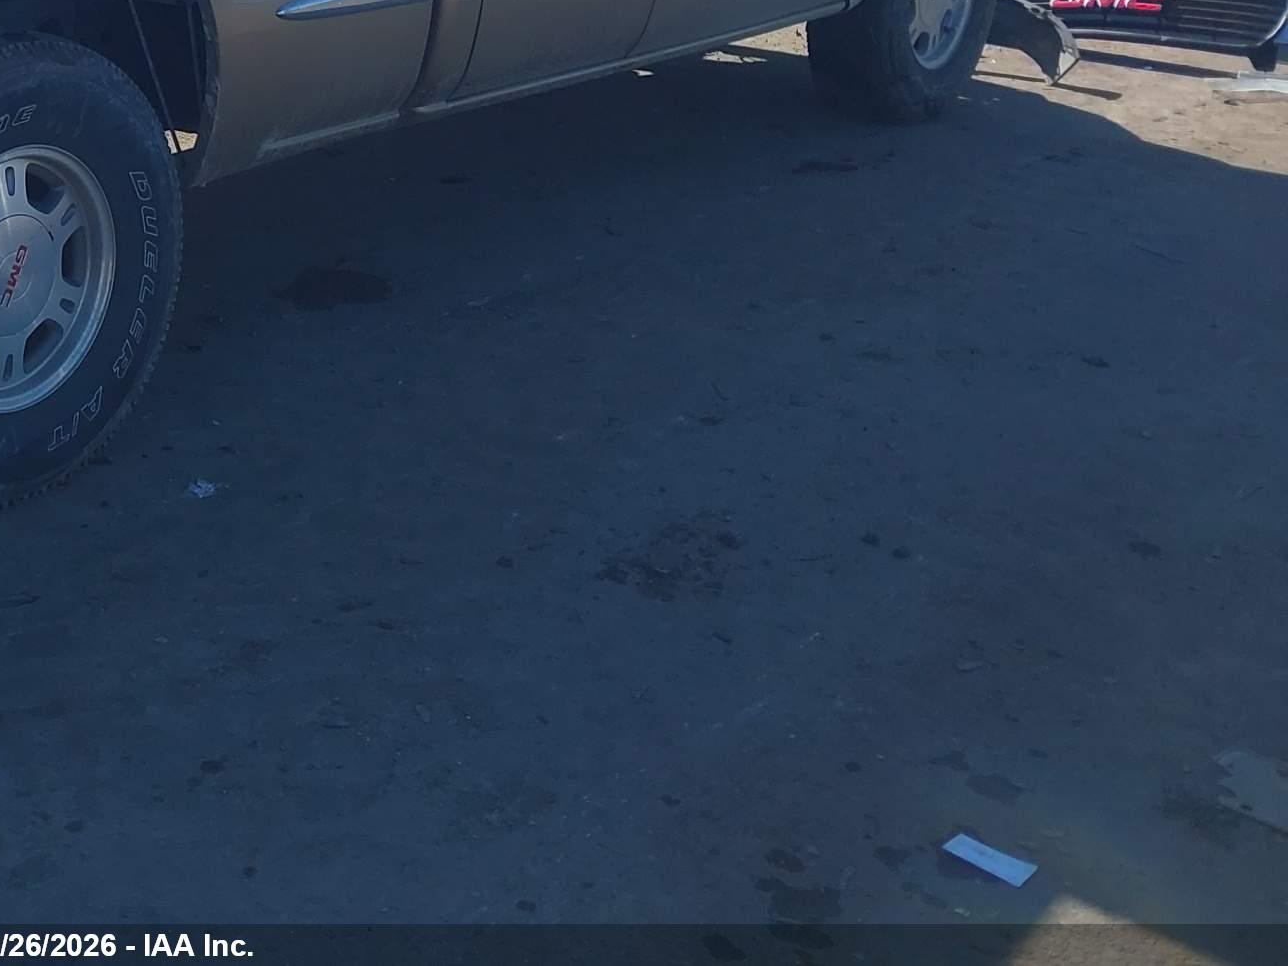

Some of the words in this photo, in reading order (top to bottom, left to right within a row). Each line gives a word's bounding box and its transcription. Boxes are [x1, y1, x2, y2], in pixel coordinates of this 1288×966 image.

[0, 245, 28, 308] GMC
[111, 170, 159, 380] DUELER
[48, 385, 104, 452] A/T
